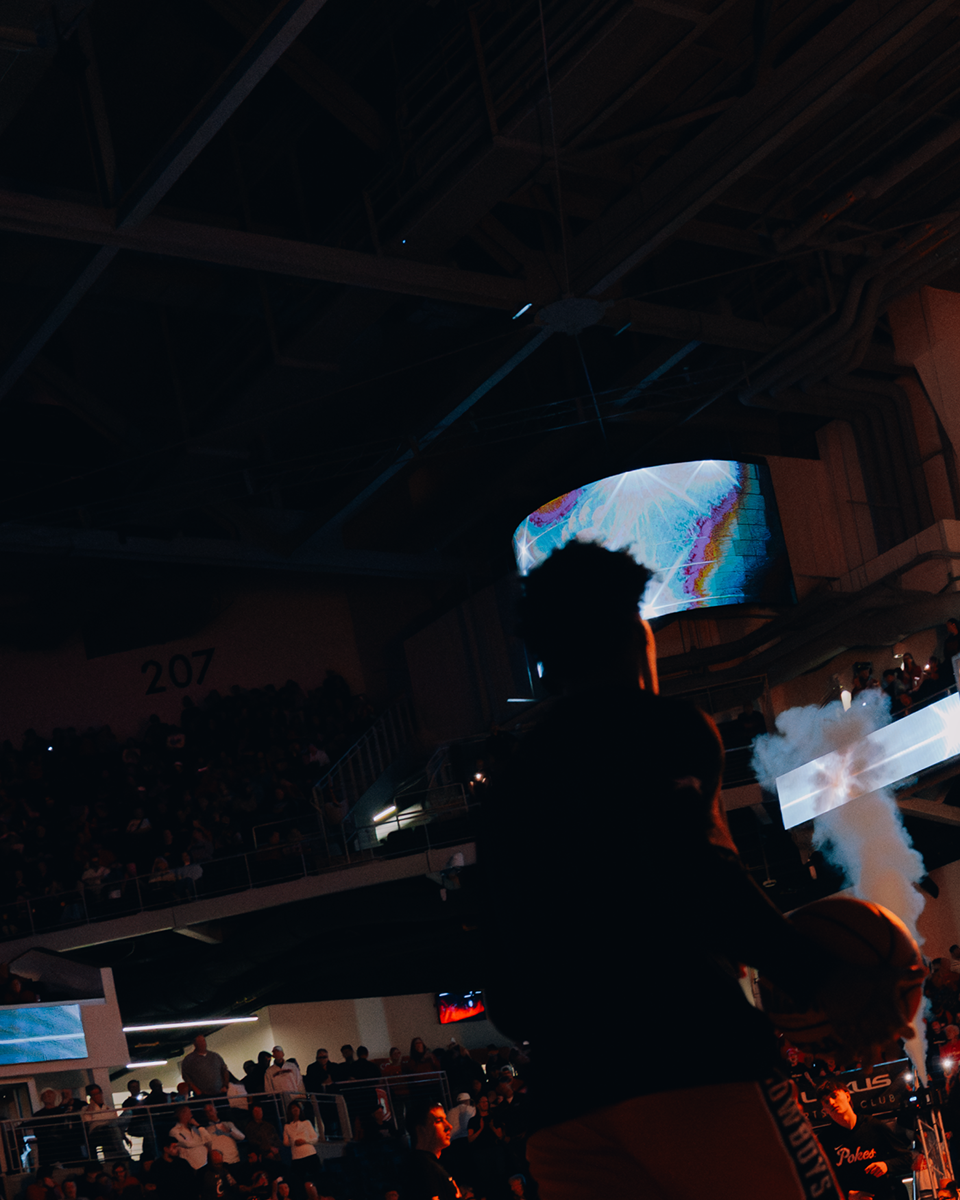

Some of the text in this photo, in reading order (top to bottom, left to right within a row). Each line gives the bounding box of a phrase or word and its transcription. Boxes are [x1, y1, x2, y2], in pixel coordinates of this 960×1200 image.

[141, 647, 216, 696] 207
[860, 1093, 896, 1109] CLUB
[765, 1078, 832, 1199] OWBOYS
[835, 1145, 877, 1167] Pokes
